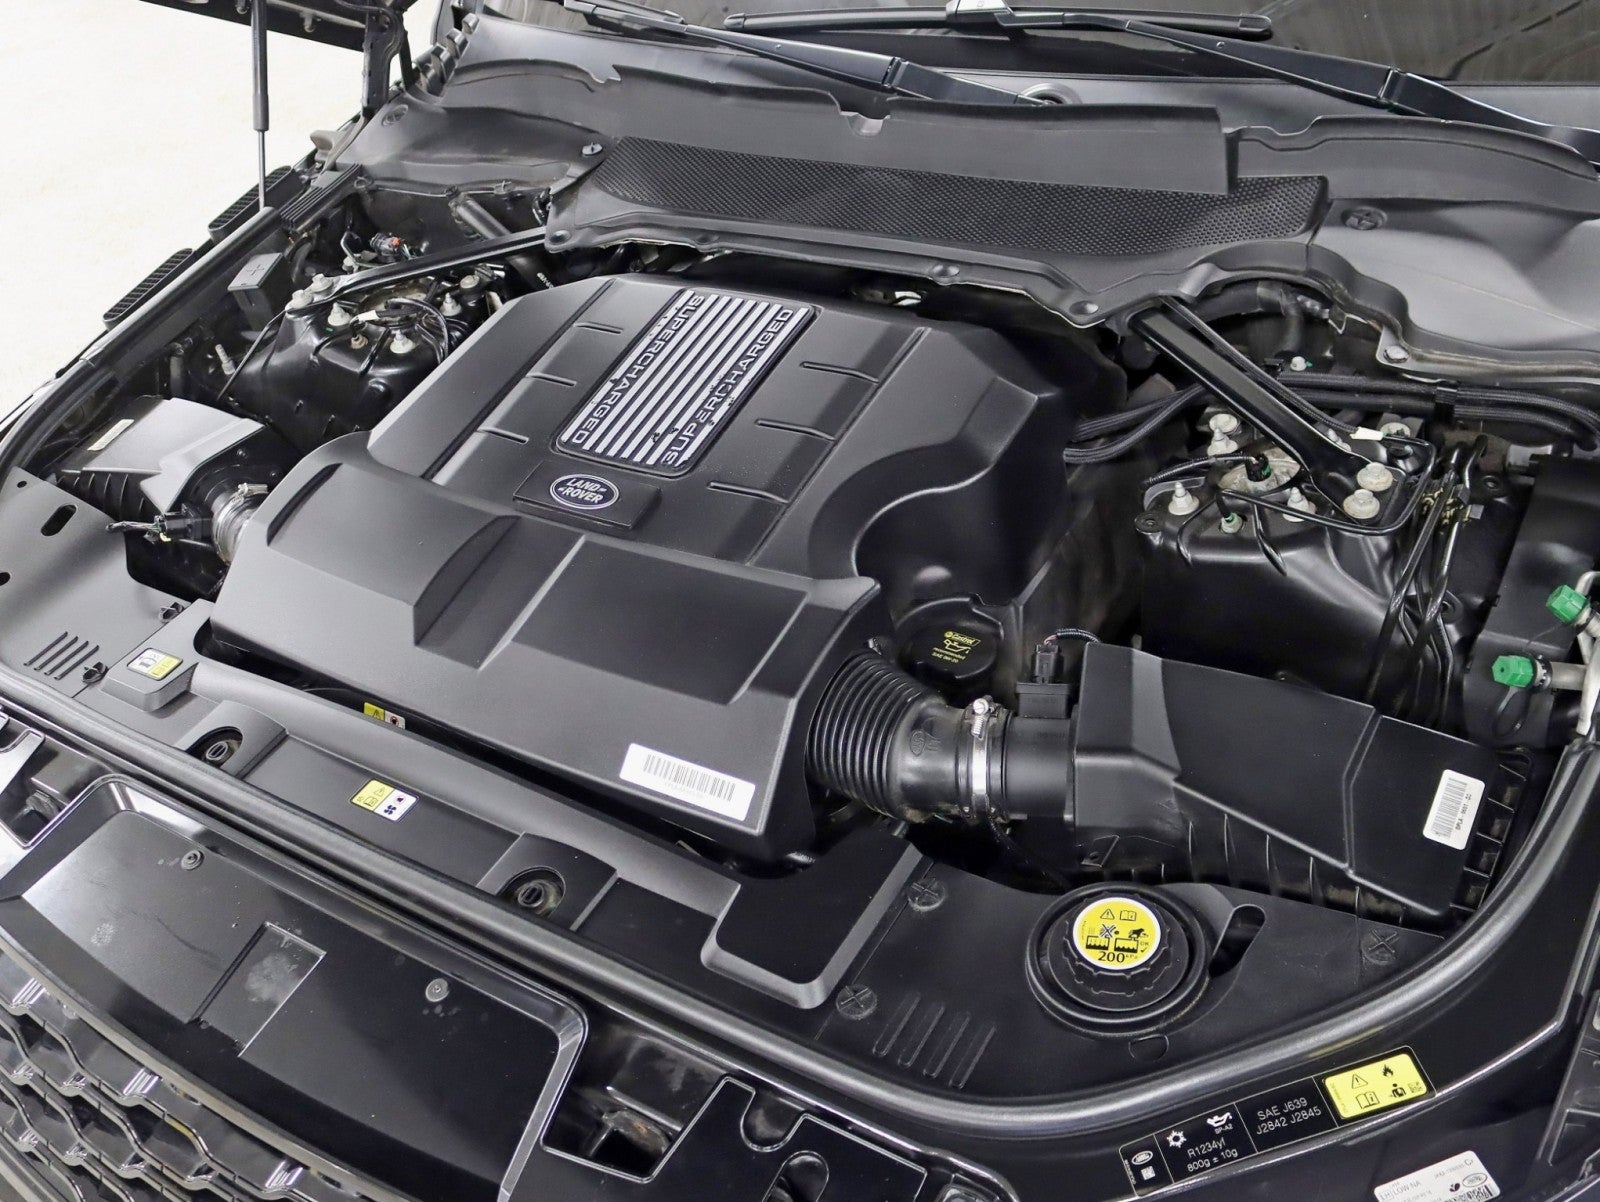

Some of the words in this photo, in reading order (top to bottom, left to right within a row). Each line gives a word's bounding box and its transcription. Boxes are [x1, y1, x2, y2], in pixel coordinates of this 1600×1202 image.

[572, 295, 705, 444] SUPERCHARGED
[661, 308, 794, 465] SUPERCHARGED
[562, 487, 604, 503] ROVER
[566, 478, 601, 492] LAND
[951, 633, 976, 645] Castrol
[1097, 951, 1125, 963] 200
[1257, 1105, 1281, 1120] SAE
[1283, 1097, 1308, 1113] J639
[1256, 1117, 1288, 1135] J2842
[1290, 1106, 1322, 1124] J2845
[1186, 1159, 1211, 1172] 800g
[1220, 1148, 1239, 1159] 10g
